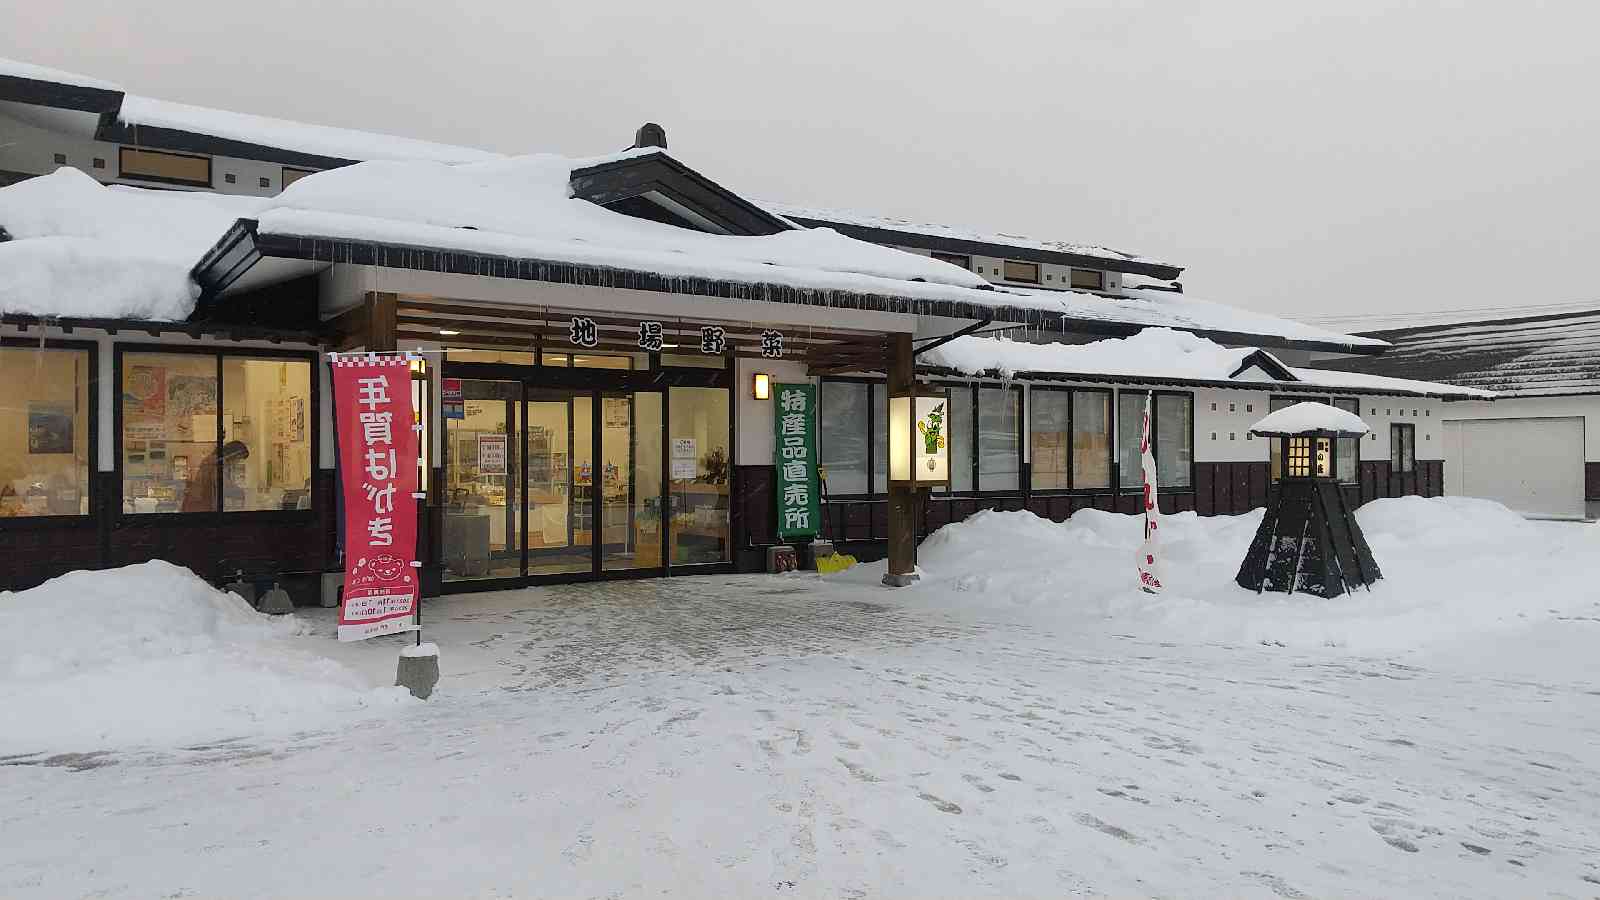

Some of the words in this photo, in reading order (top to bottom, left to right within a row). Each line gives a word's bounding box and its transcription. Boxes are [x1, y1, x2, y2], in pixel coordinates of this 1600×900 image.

[569, 317, 784, 358] 地場野菜
[781, 389, 809, 529] 特産品直売所
